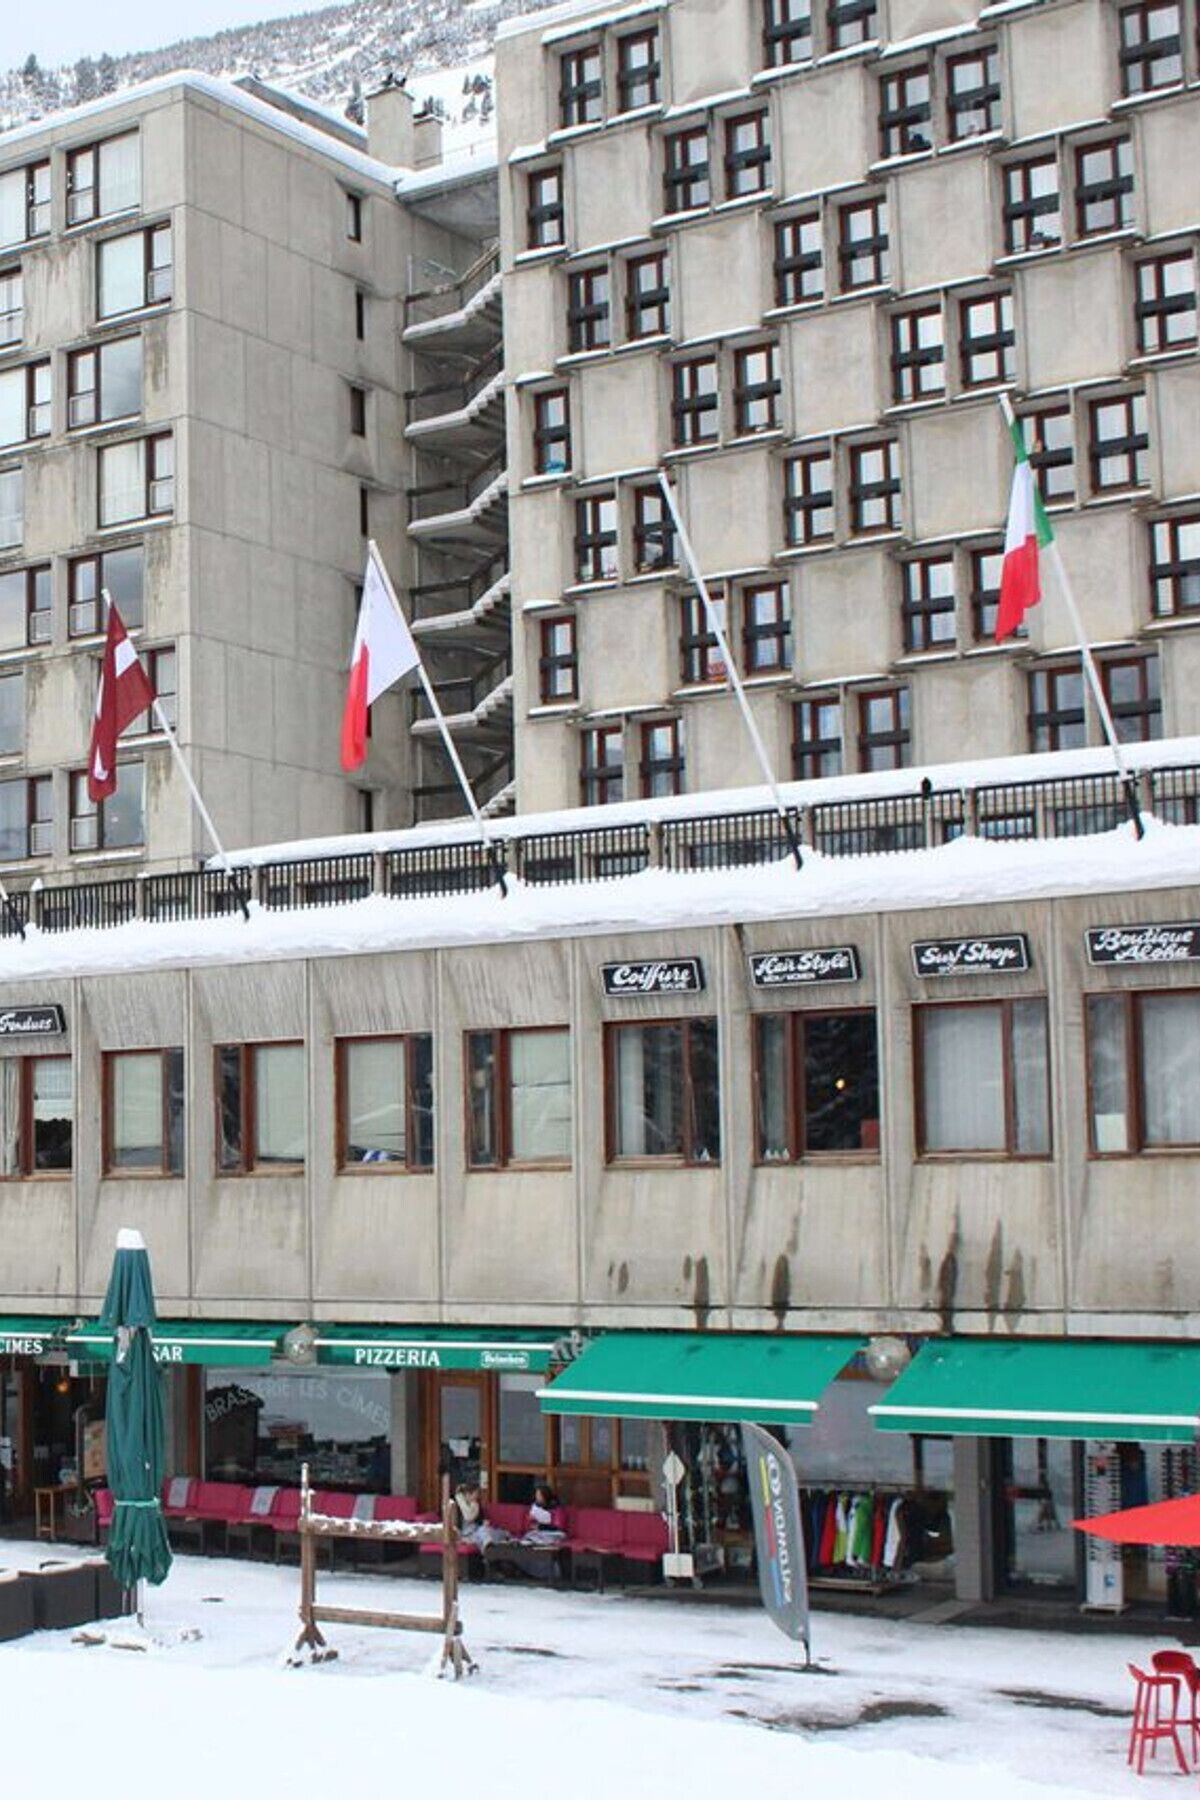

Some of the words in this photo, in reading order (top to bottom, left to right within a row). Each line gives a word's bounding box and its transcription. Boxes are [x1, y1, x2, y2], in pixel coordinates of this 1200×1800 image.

[1094, 928, 1194, 950] Boutique
[755, 957, 795, 976] Hair
[797, 952, 848, 974] Style
[920, 943, 967, 965] Surf
[964, 942, 1018, 966] Shop
[613, 962, 691, 991] Coiffure
[354, 1349, 440, 1366] PIZZERIA
